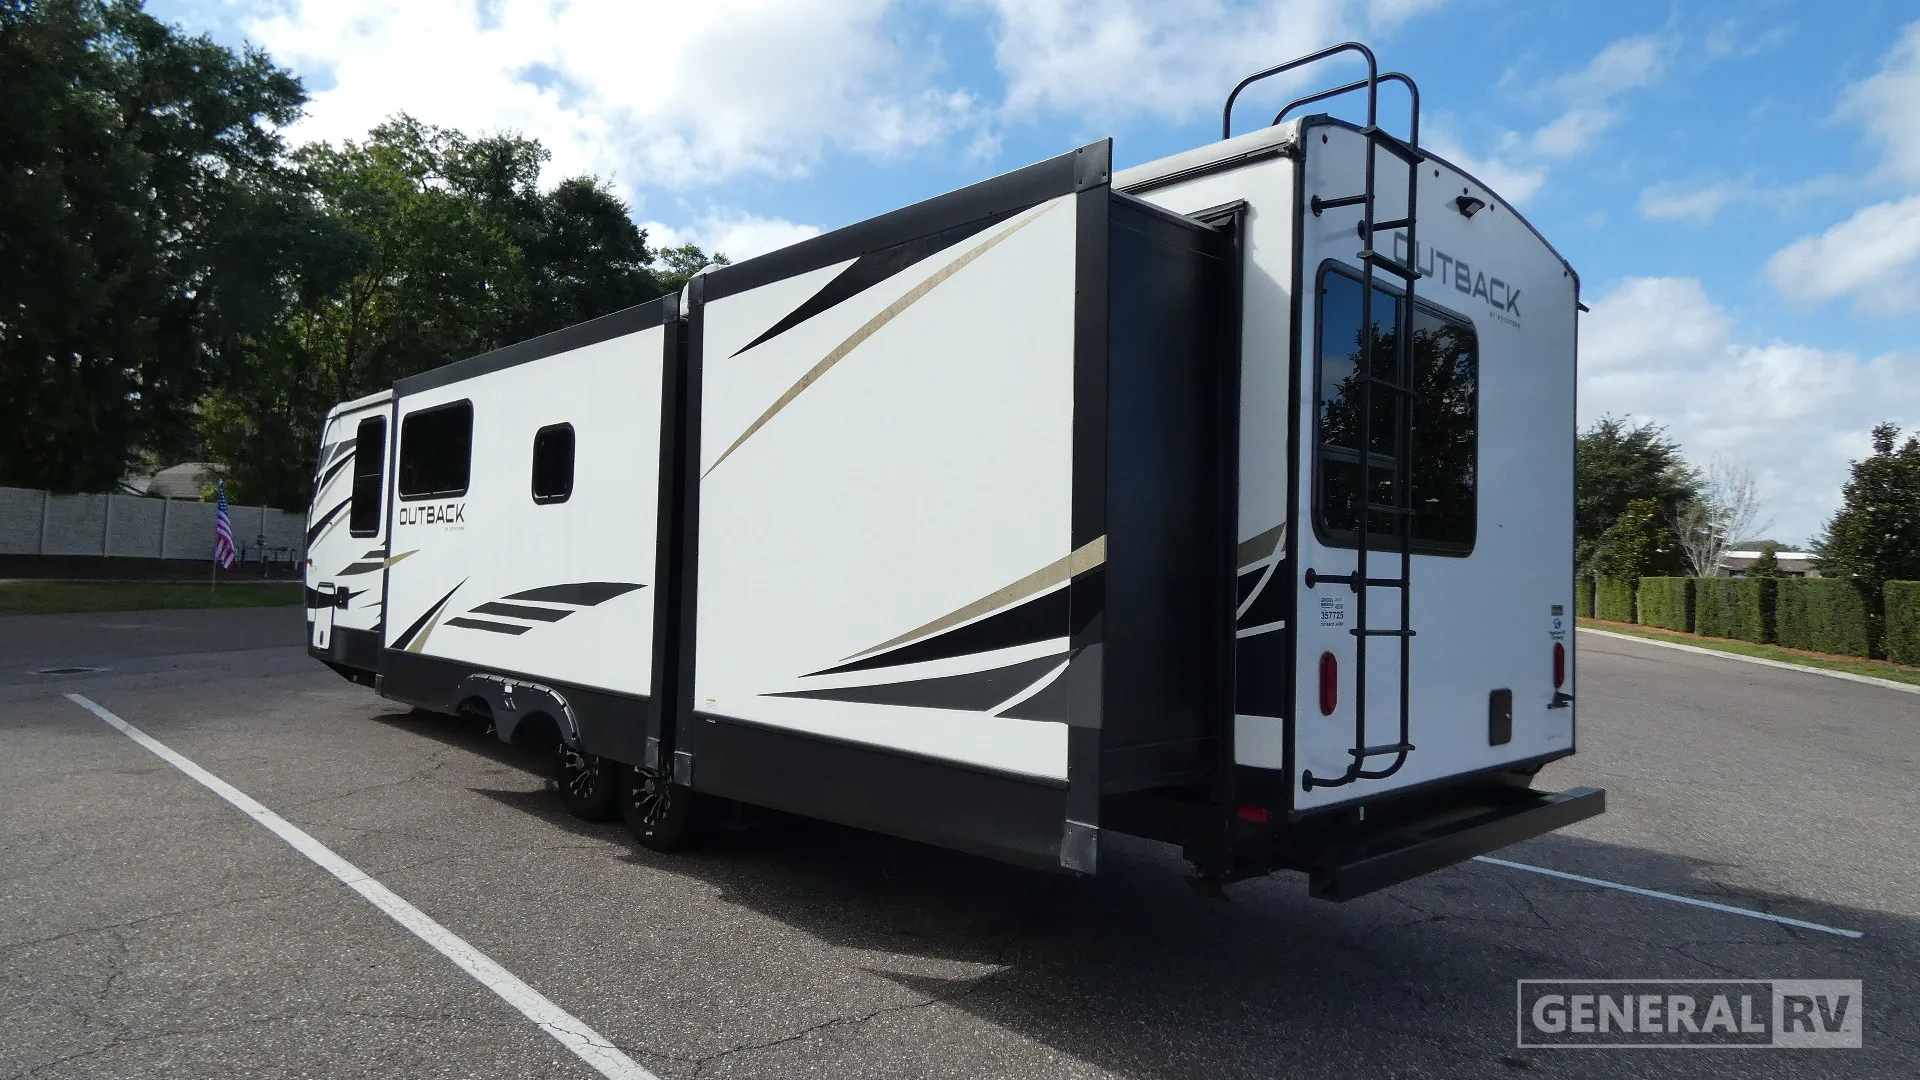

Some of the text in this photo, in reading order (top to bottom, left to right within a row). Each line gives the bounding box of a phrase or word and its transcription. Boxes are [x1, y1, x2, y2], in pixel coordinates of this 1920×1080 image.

[1394, 231, 1521, 317] OUTBACK
[400, 503, 465, 525] OUTBACK
[1321, 611, 1344, 620] 357725
